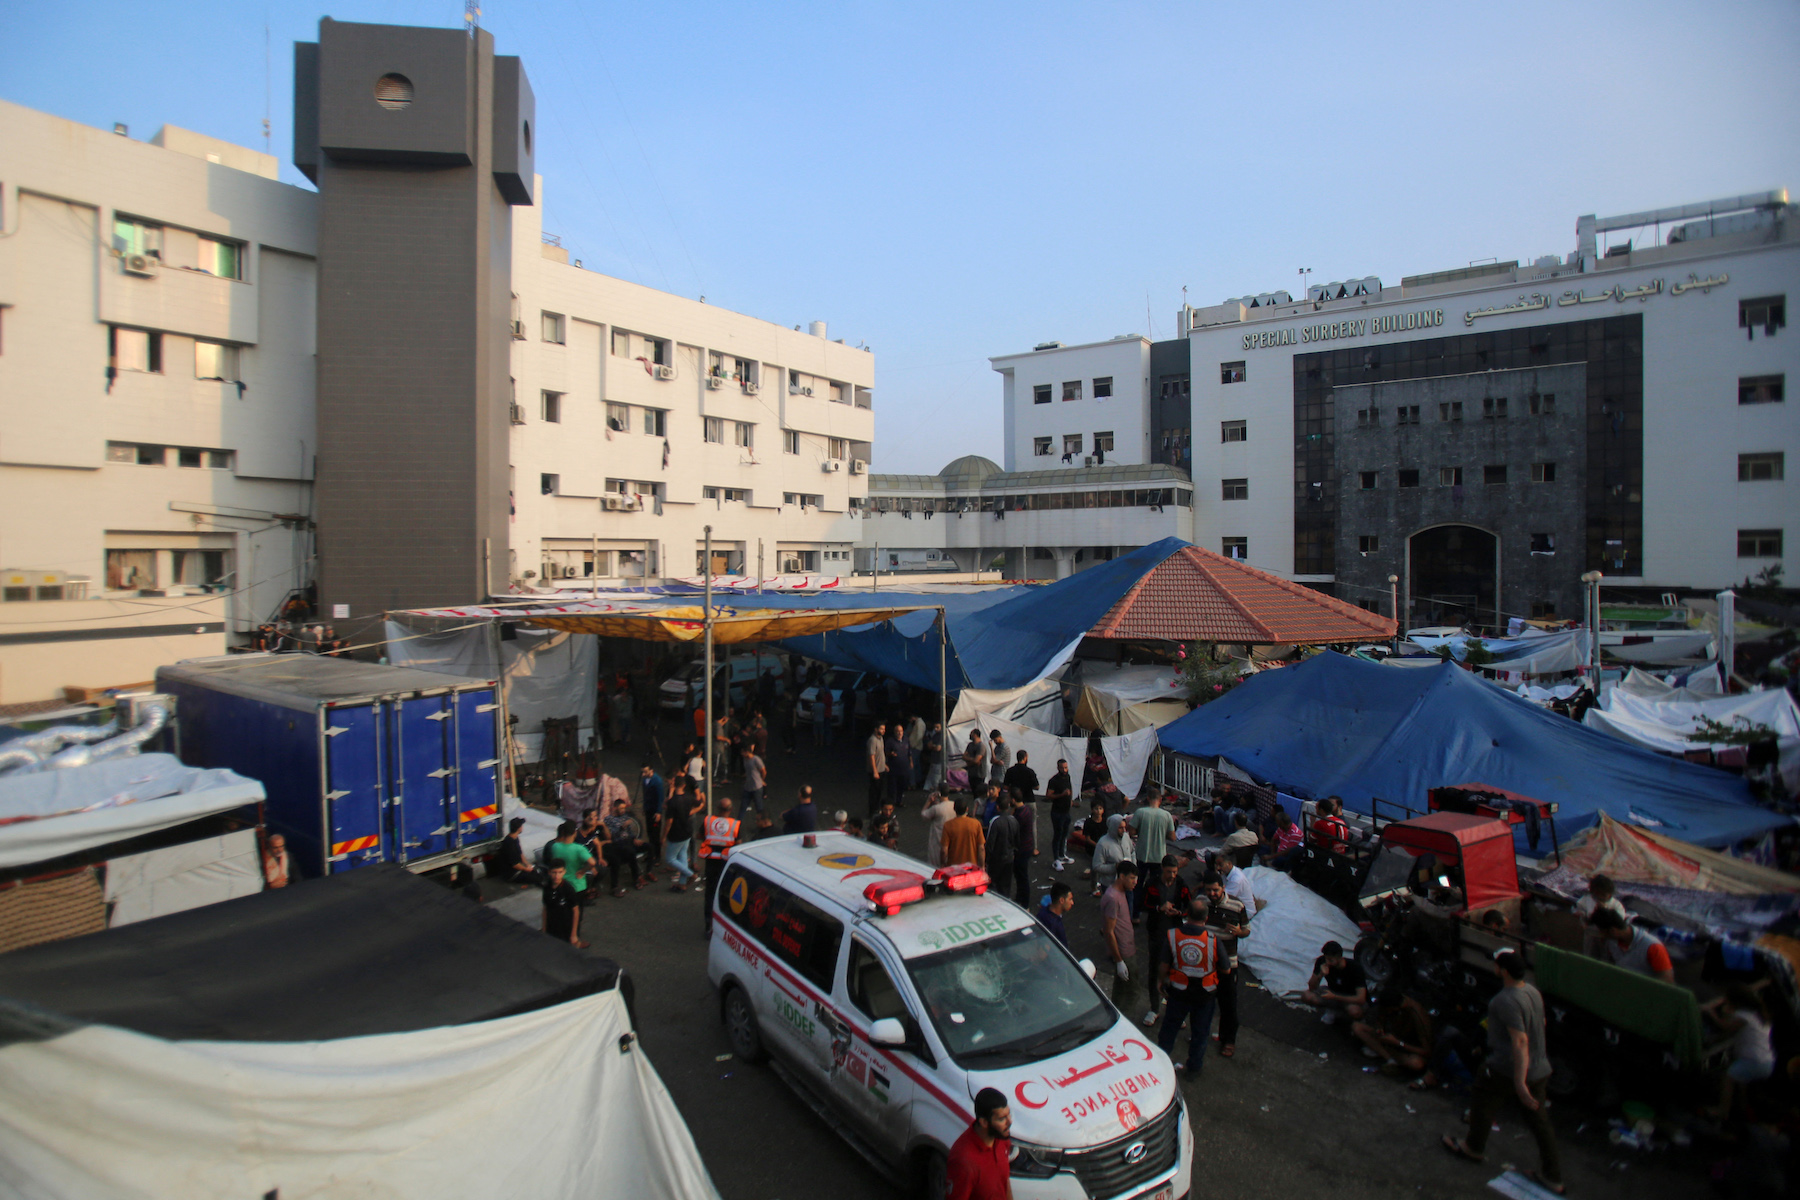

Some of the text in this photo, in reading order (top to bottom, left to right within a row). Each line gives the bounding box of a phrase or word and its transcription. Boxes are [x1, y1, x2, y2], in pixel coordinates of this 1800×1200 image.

[1464, 272, 1729, 327] مبنى الجراحات التخصصي
[1242, 308, 1443, 351] SPECIAL SURGERY BUILDING
[723, 931, 759, 970] AMBULANCE
